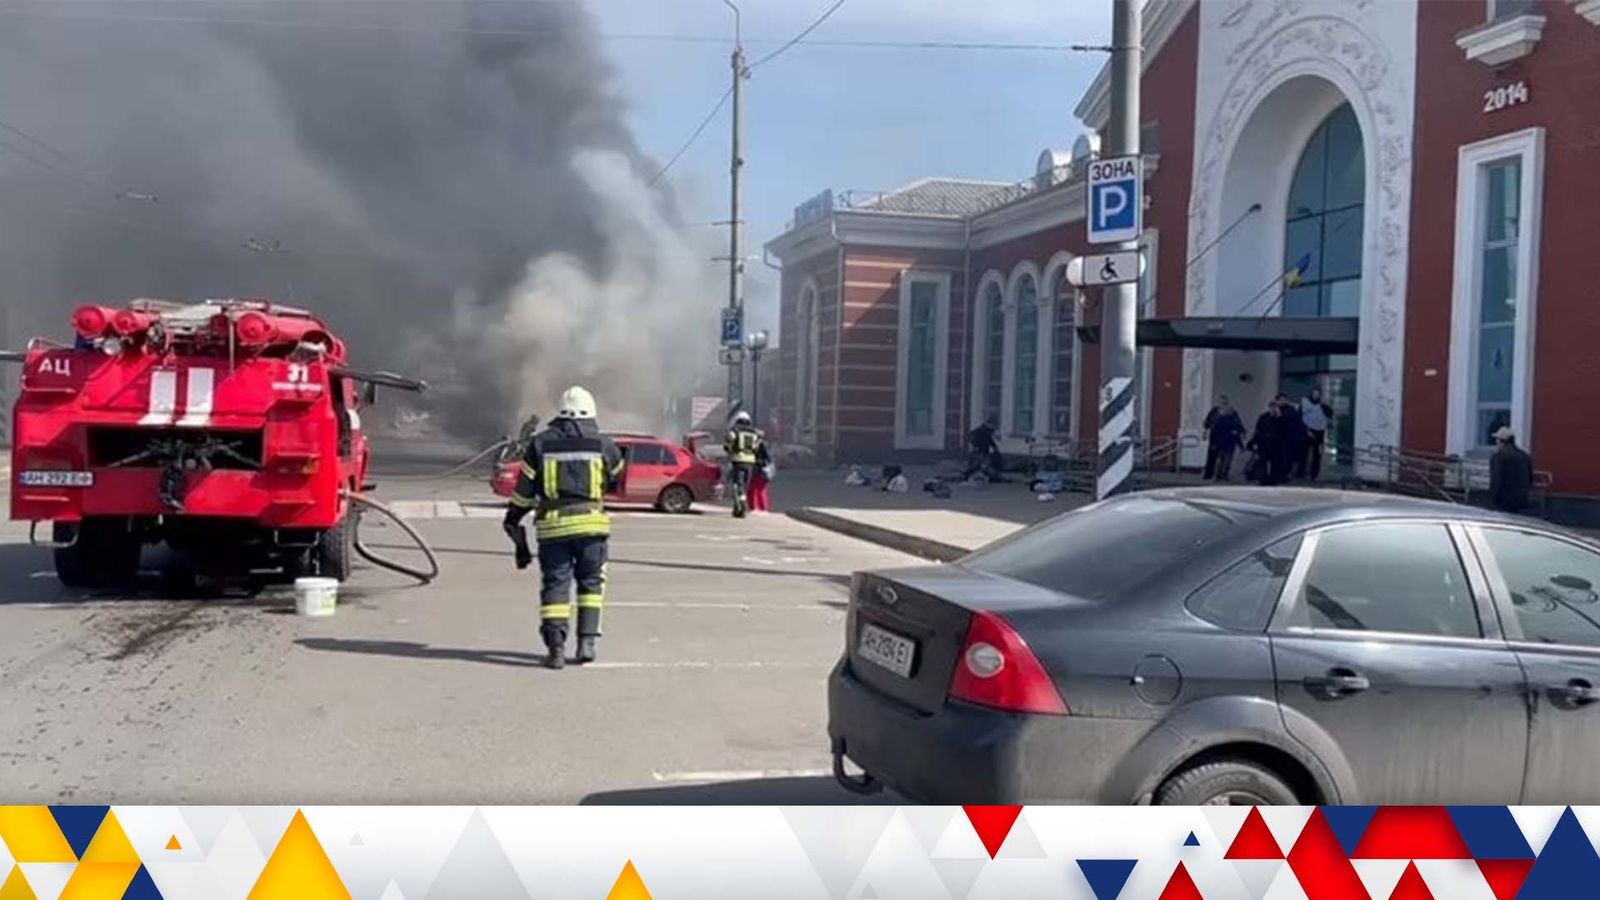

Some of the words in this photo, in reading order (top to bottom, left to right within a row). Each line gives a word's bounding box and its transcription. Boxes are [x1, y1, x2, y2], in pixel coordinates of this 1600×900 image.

[1483, 81, 1528, 112] 2014
[1092, 161, 1134, 180] ЗОНА
[1100, 185, 1127, 228] P
[38, 358, 71, 377] АЦ
[287, 363, 308, 382] 31
